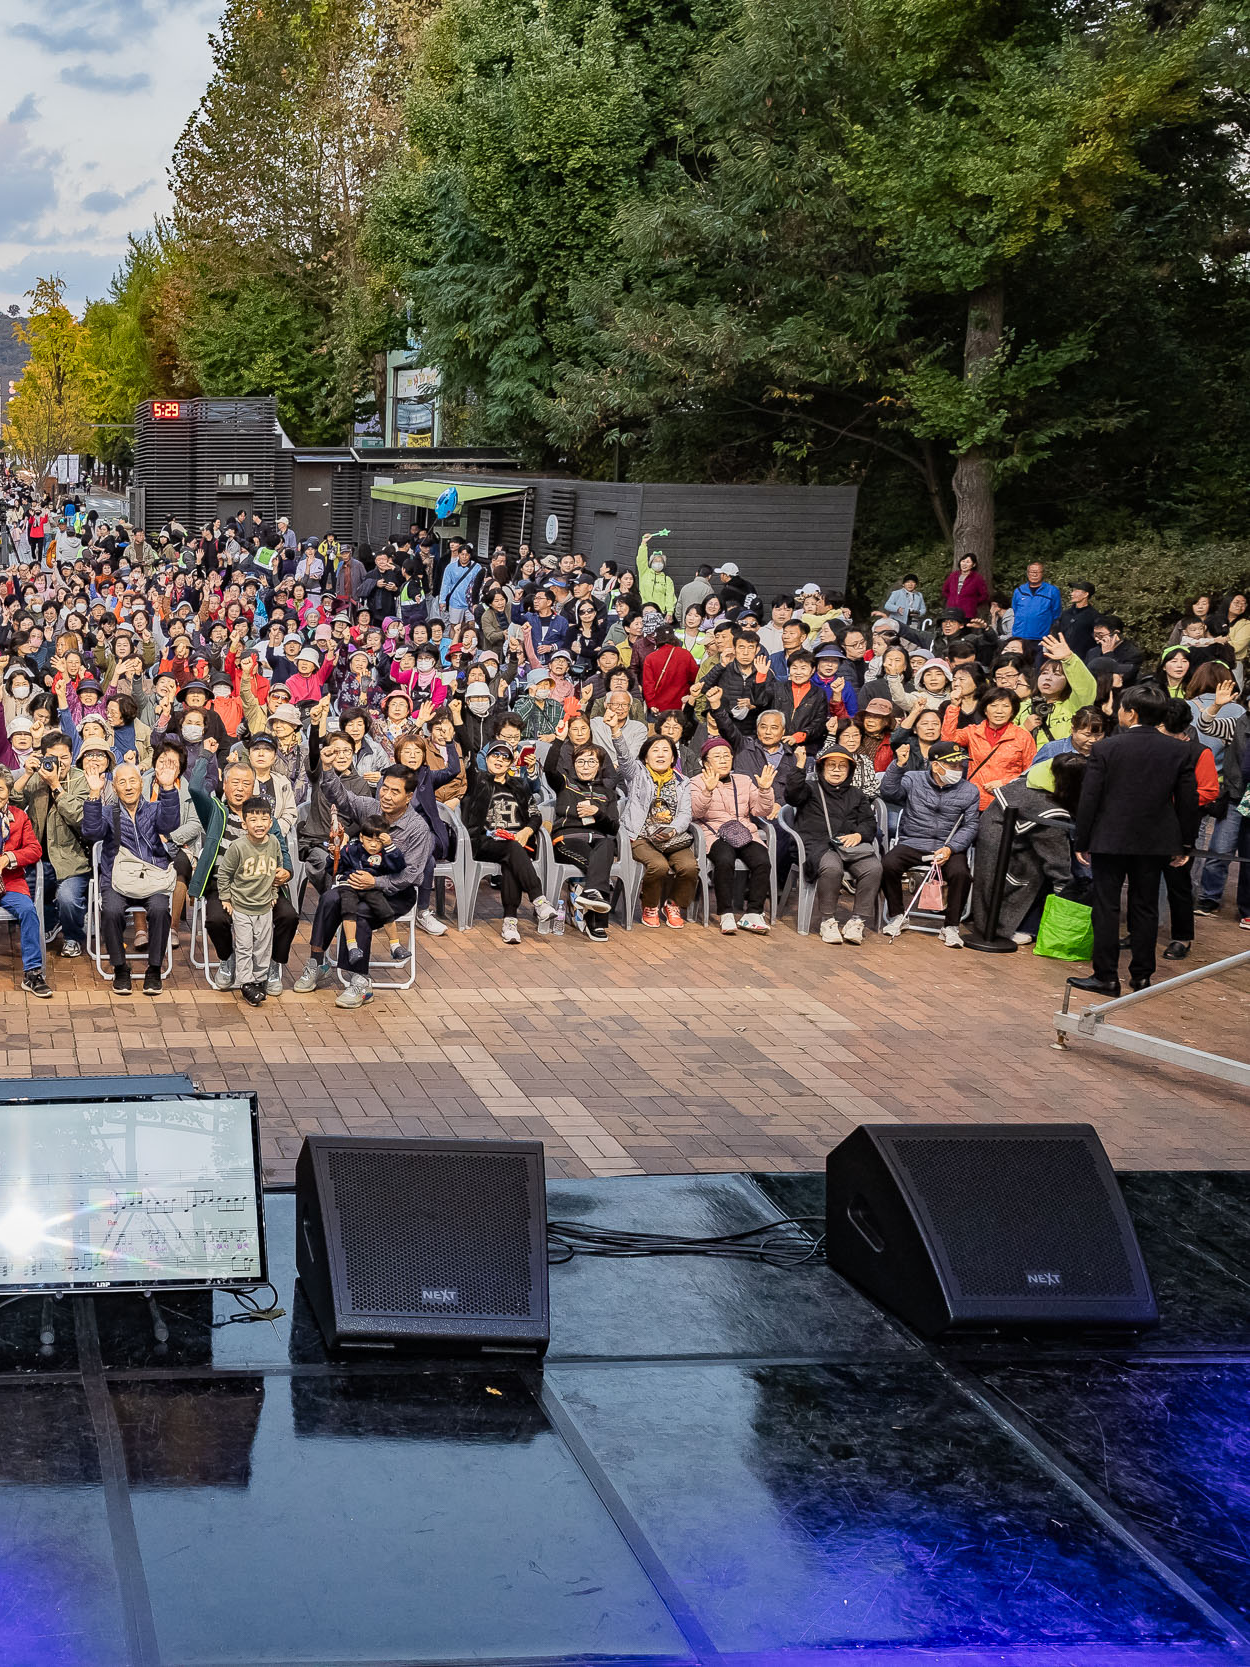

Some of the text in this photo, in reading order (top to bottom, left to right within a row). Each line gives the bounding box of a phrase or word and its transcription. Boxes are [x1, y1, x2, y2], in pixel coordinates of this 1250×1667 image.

[154, 403, 179, 417] 5:29
[242, 853, 278, 878] GAP
[1027, 1272, 1061, 1286] NEXT
[422, 1289, 457, 1302] NEXT
